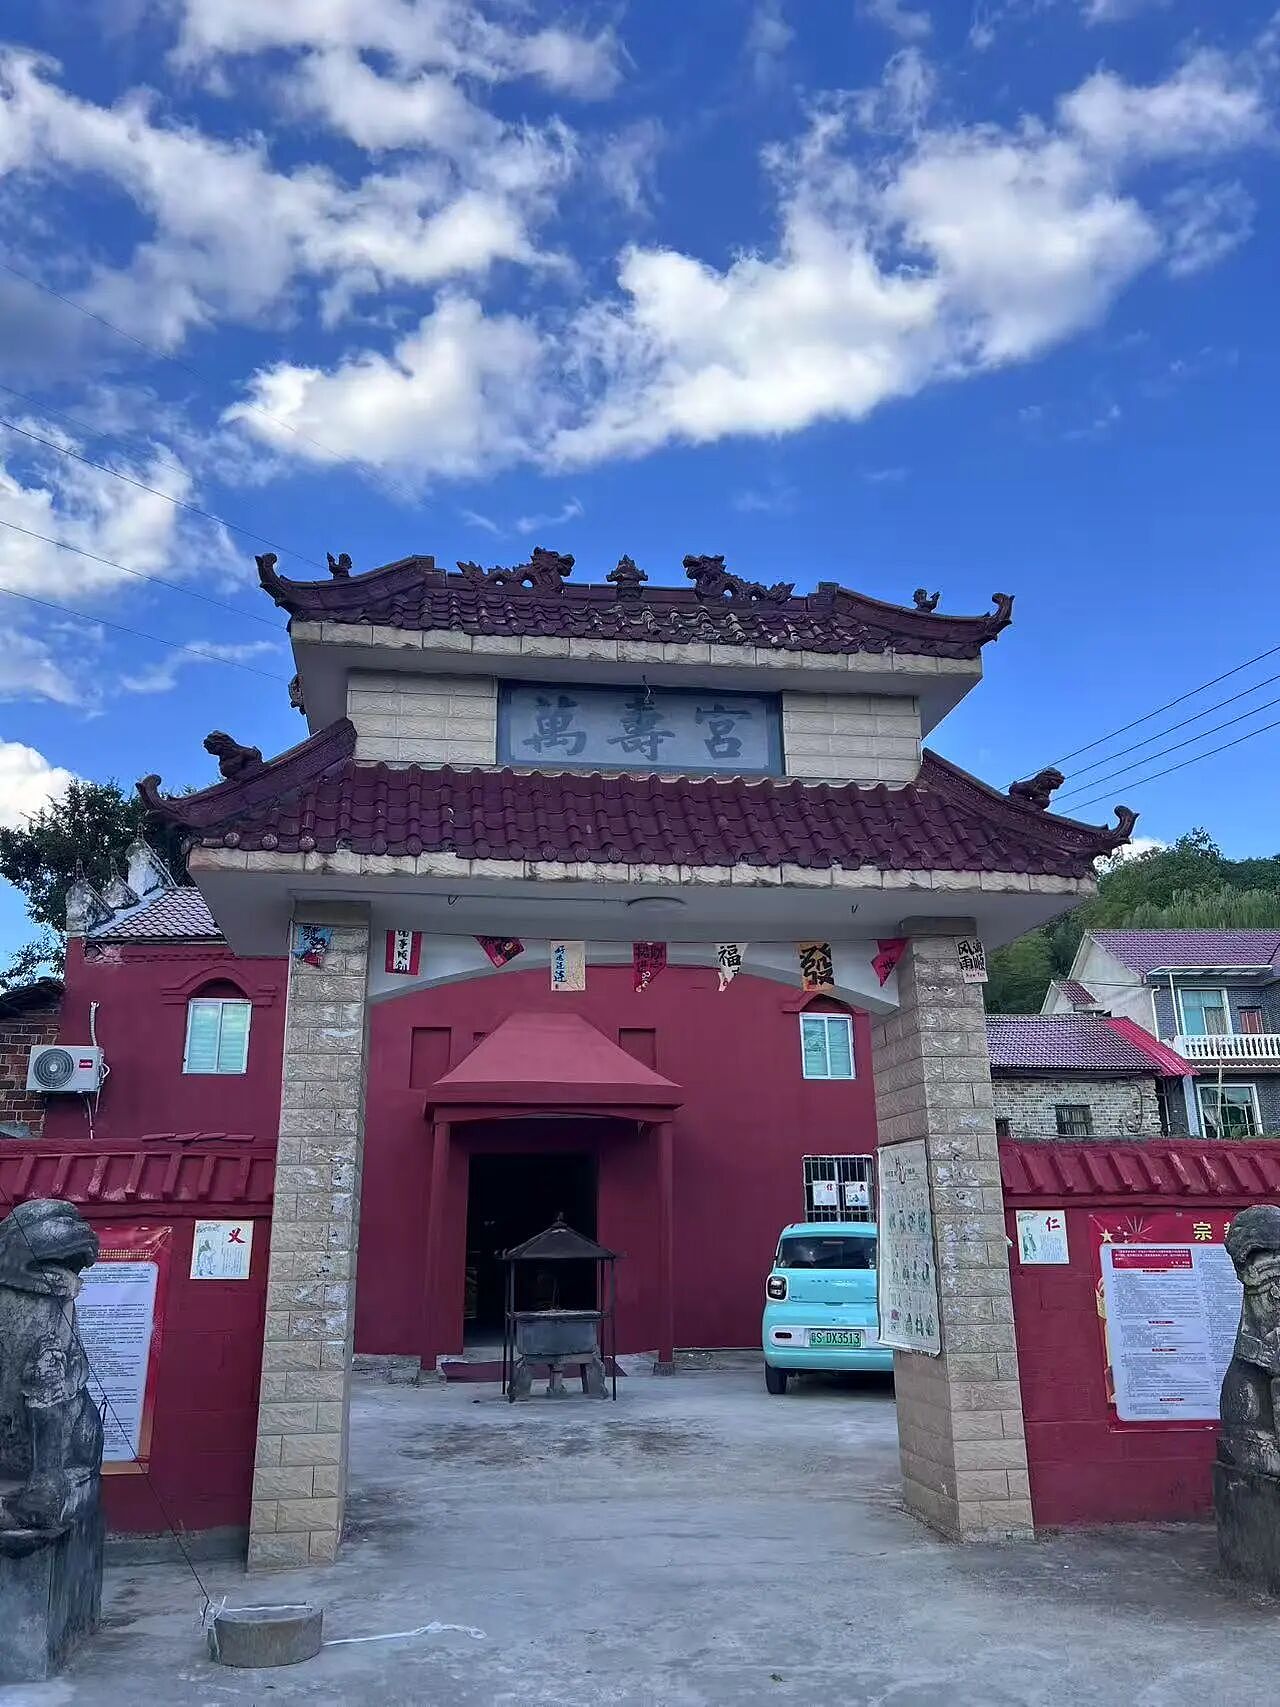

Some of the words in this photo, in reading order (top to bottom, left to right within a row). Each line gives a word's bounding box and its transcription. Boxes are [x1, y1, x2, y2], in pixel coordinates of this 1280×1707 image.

[522, 694, 752, 761] 萬壽宮
[718, 944, 741, 968] 福
[1046, 1216, 1061, 1232] 仁
[227, 1227, 246, 1244] 义
